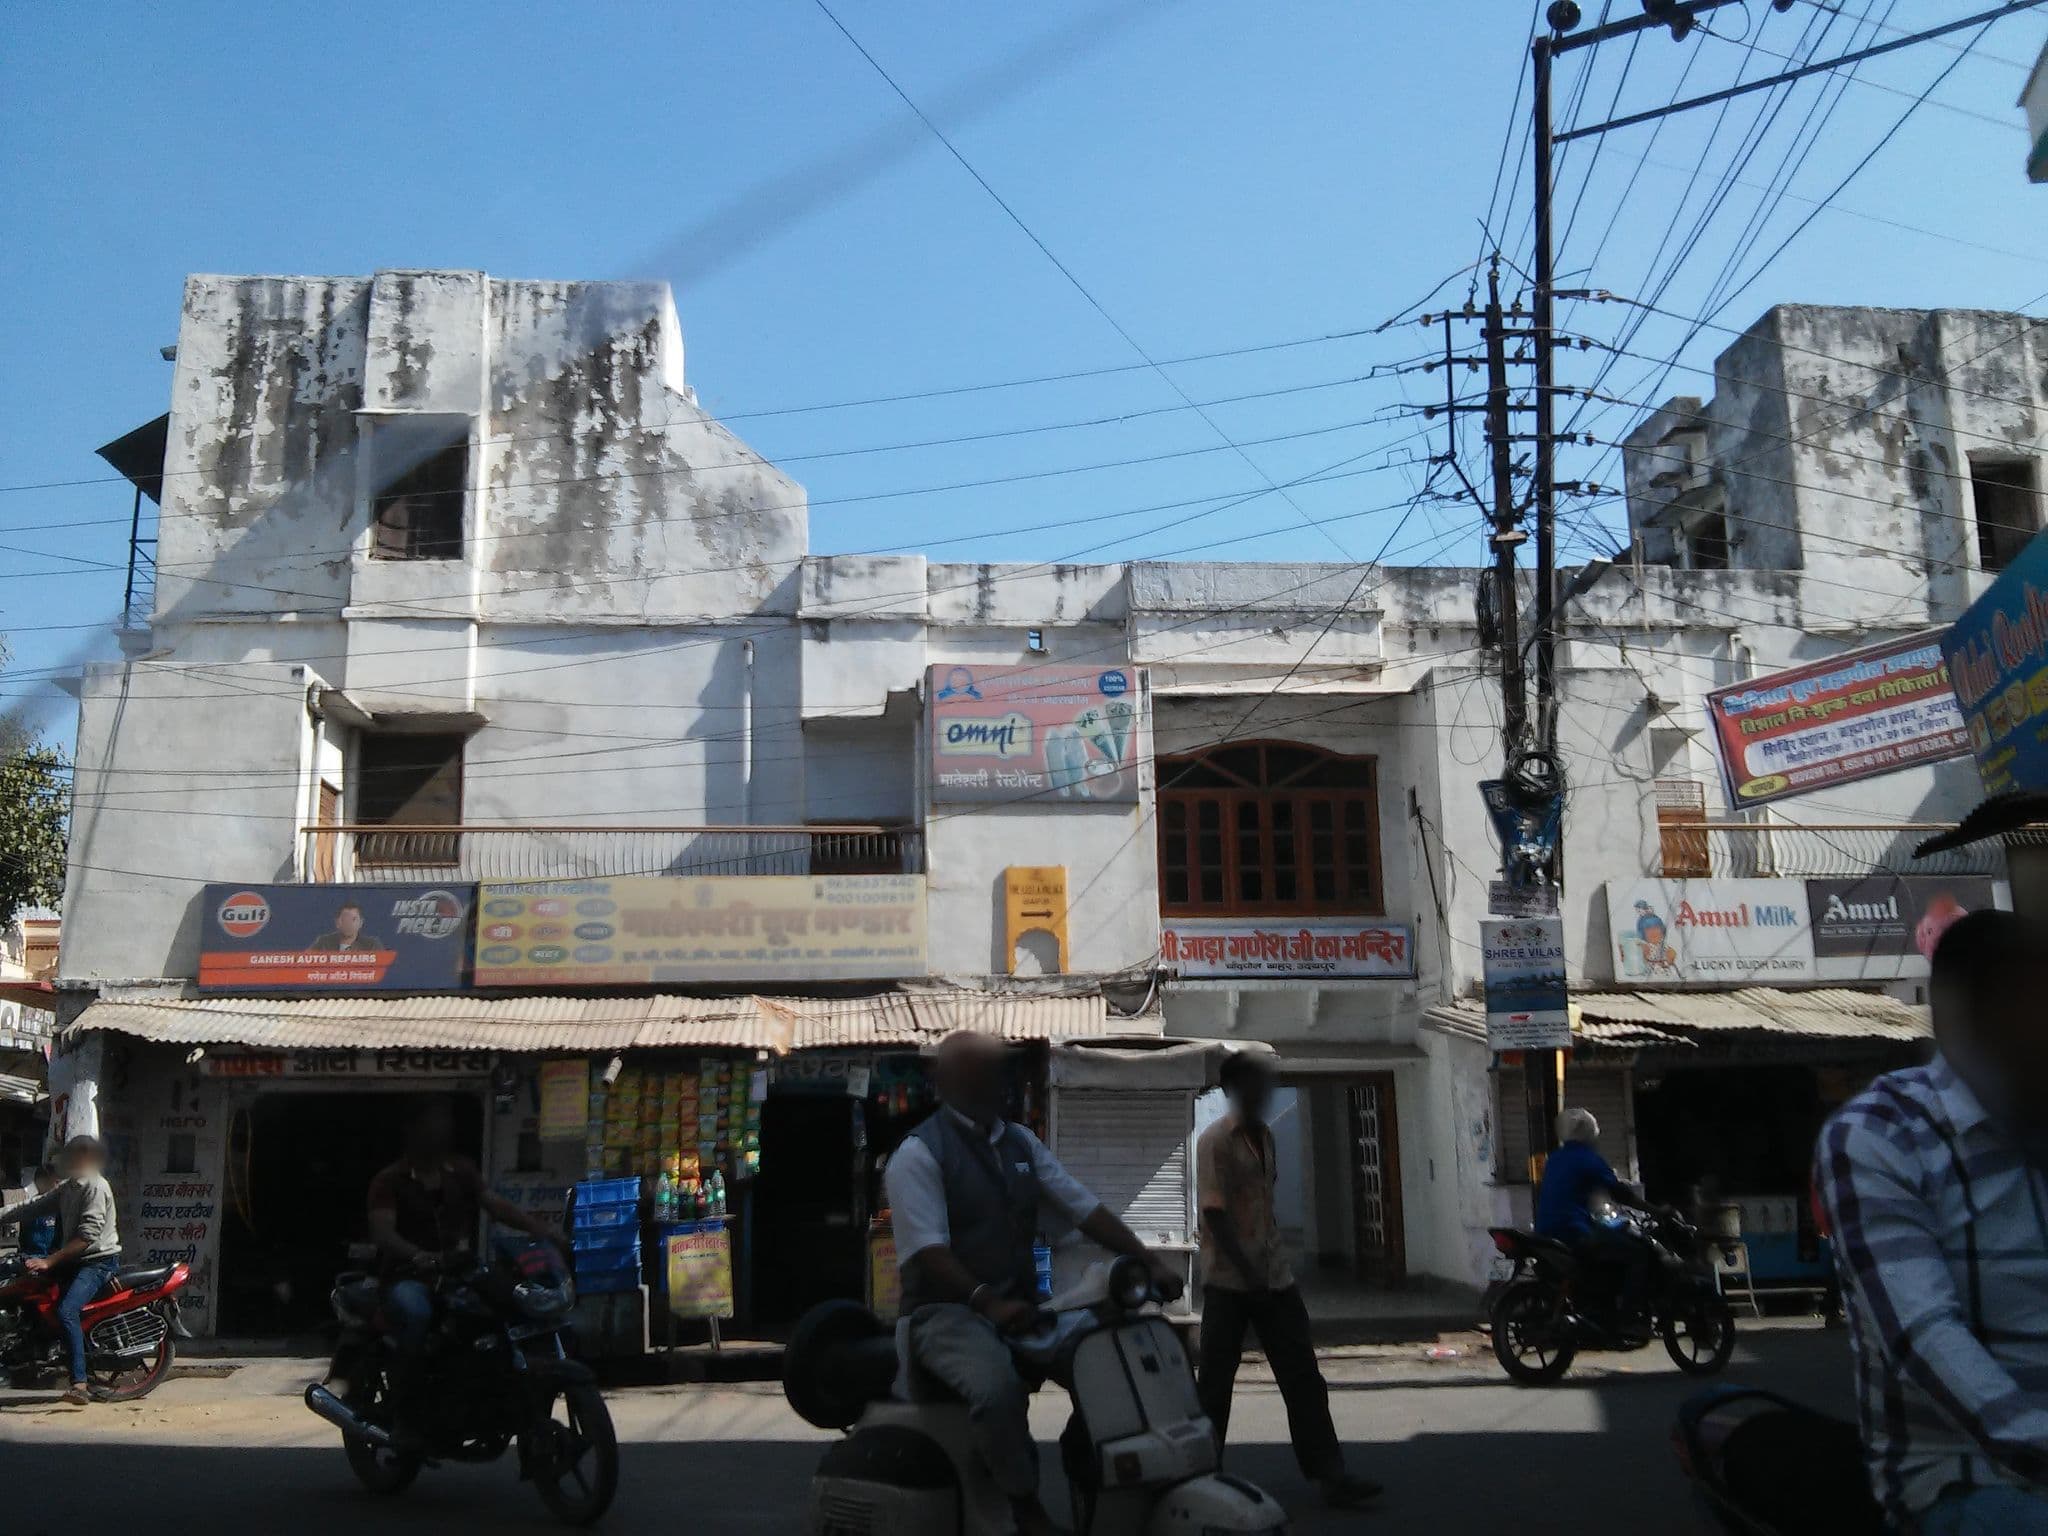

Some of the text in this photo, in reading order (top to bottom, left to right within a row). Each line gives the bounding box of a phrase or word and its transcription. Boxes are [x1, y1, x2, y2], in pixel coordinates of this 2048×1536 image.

[222, 908, 266, 921] Gulf
[1676, 900, 1798, 928] Amul Milk
[1823, 894, 1899, 923] Amul
[1228, 929, 1288, 961] गणेश
[250, 954, 376, 964] GANESH AUTO REPAIRS
[1485, 947, 1561, 960] SHREE VILAS
[1296, 961, 1336, 972] उदयपुर
[1695, 960, 1731, 971] LUCKY
[1772, 960, 1805, 971] DAIRY
